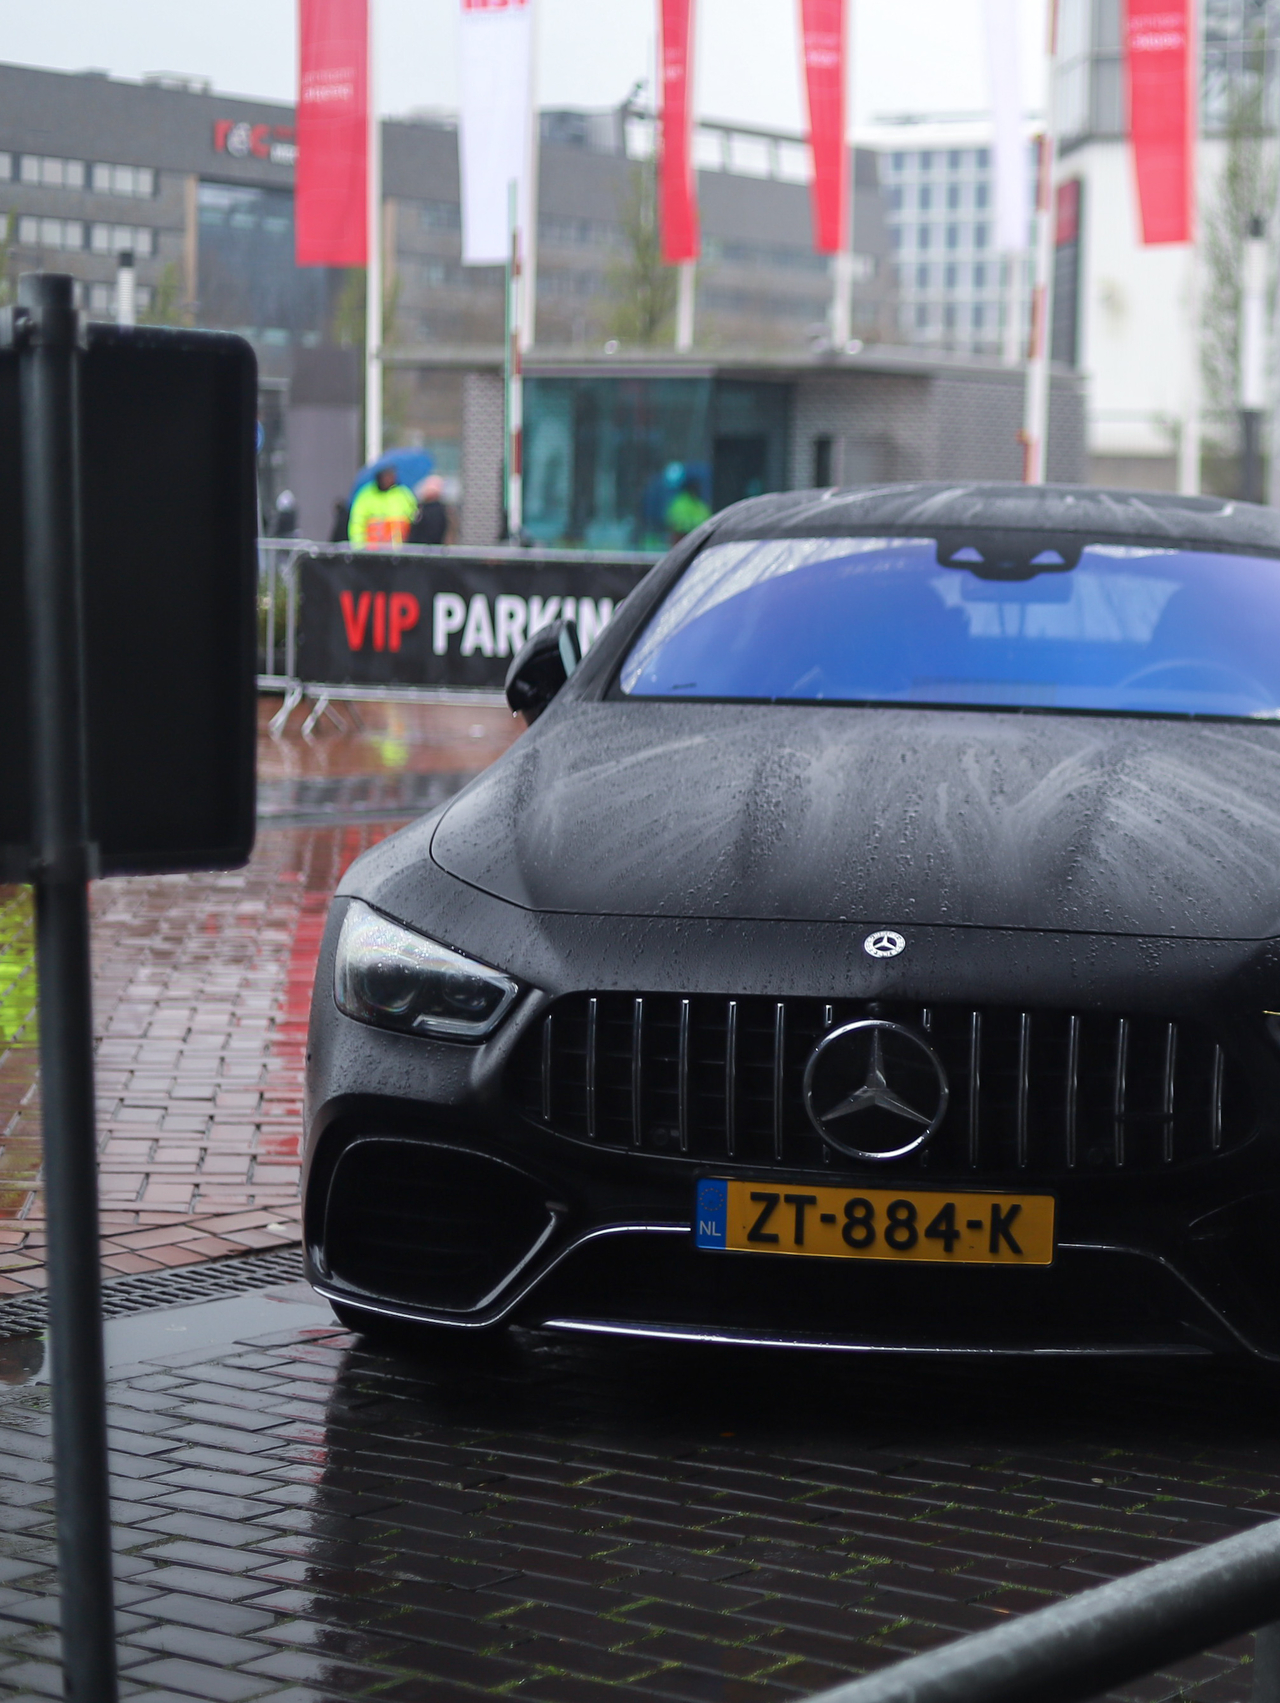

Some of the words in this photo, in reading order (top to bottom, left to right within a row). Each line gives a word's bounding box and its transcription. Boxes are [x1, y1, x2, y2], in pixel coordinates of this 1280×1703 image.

[340, 591, 420, 652] VIP
[432, 592, 626, 658] PARKN
[699, 1220, 722, 1237] NL
[747, 1191, 1023, 1254] ZT-884-K
